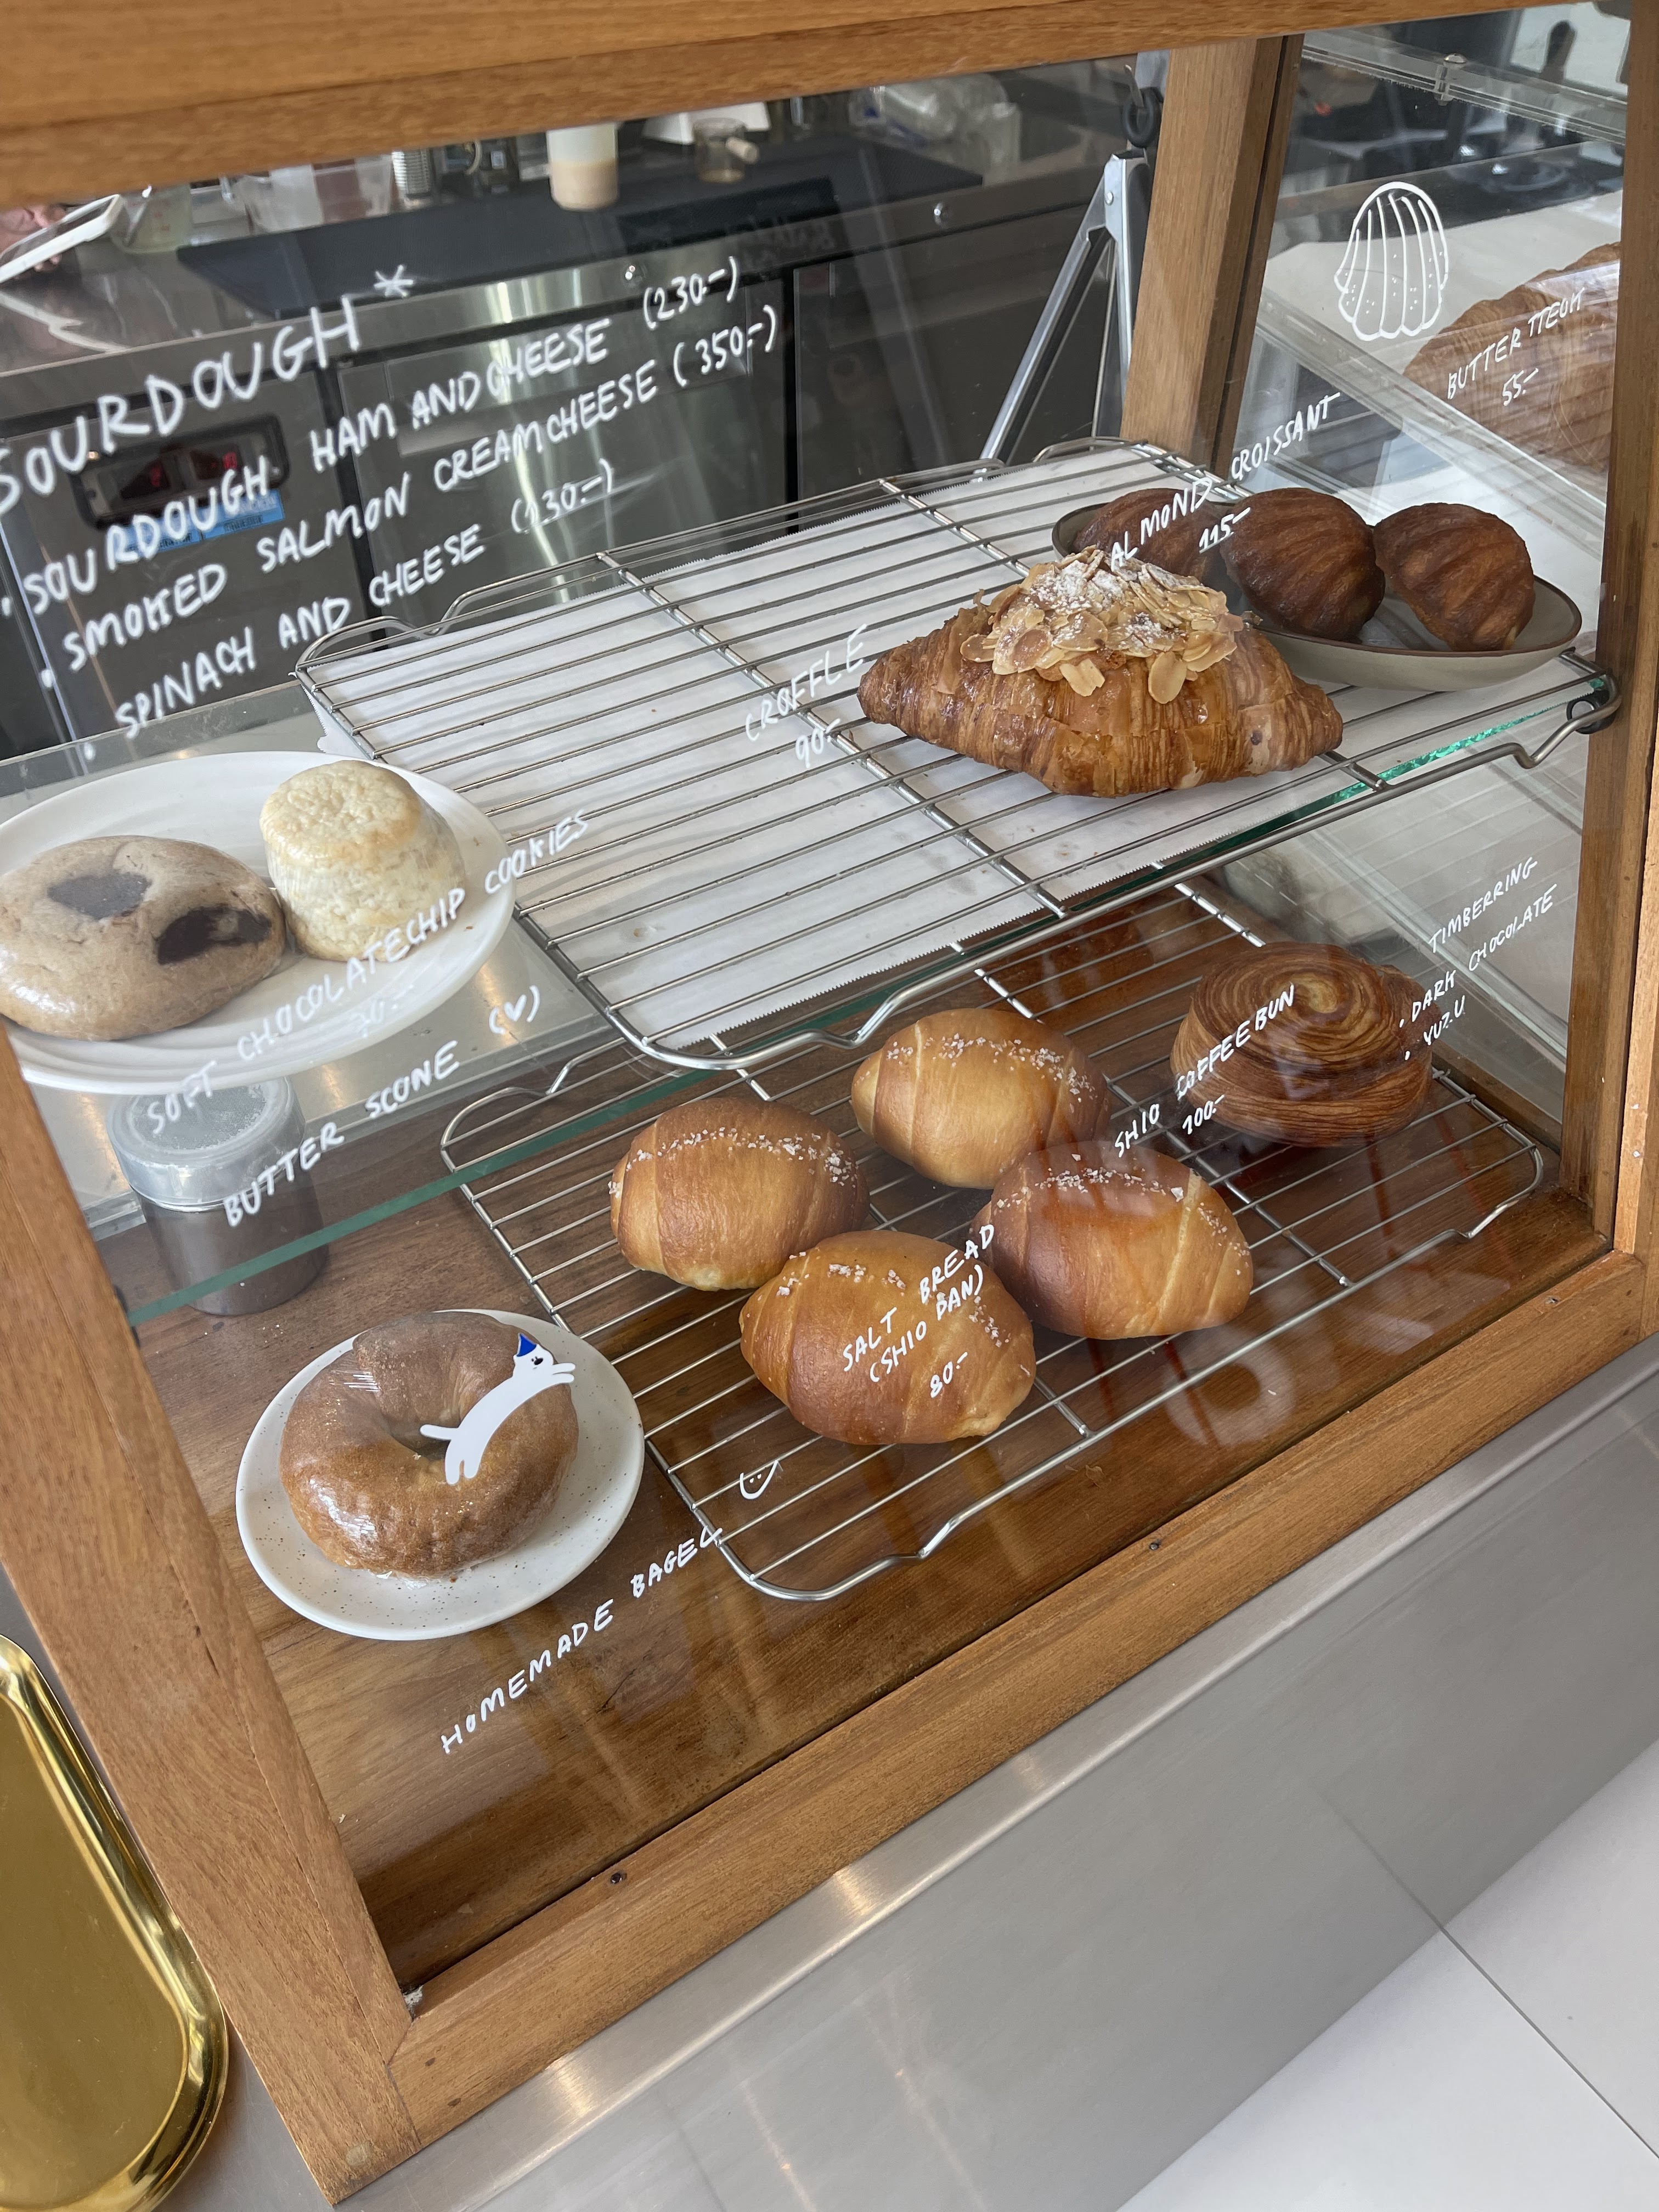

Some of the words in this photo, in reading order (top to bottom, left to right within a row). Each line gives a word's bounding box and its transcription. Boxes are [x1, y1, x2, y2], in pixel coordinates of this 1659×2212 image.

[0, 295, 360, 515] SOURDOUGH
[1447, 326, 1521, 399] BUTTER
[23, 455, 270, 613] SOURDOUGH
[310, 403, 397, 472] HAM
[64, 563, 228, 672] SMOKED
[257, 472, 411, 573] SALMON
[1110, 477, 1213, 572] ALMOND
[1231, 392, 1341, 481] CROISSANT
[115, 626, 257, 738] SPINACH
[277, 597, 350, 648] AND
[369, 523, 486, 607] CHEESE
[745, 623, 868, 742] CROFFLE
[148, 1060, 218, 1136] SOFT
[484, 808, 589, 895] COOKIES
[1412, 970, 1456, 1022] DARK
[1468, 883, 1558, 972] CHOCOLATE
[1427, 856, 1538, 953] TIMBERRING
[223, 1121, 345, 1228] BUTTER
[365, 1040, 460, 1120] SCONE
[1114, 1103, 1160, 1158] SHIO
[1176, 1020, 1251, 1101] COFFEE
[1254, 984, 1295, 1031] BUN
[842, 1307, 897, 1372] SALT
[919, 1224, 995, 1305] BREAD
[870, 1321, 927, 1383] (SHIO
[440, 1598, 614, 1754] HOMEMADE
[630, 1525, 723, 1598] BAGEL
